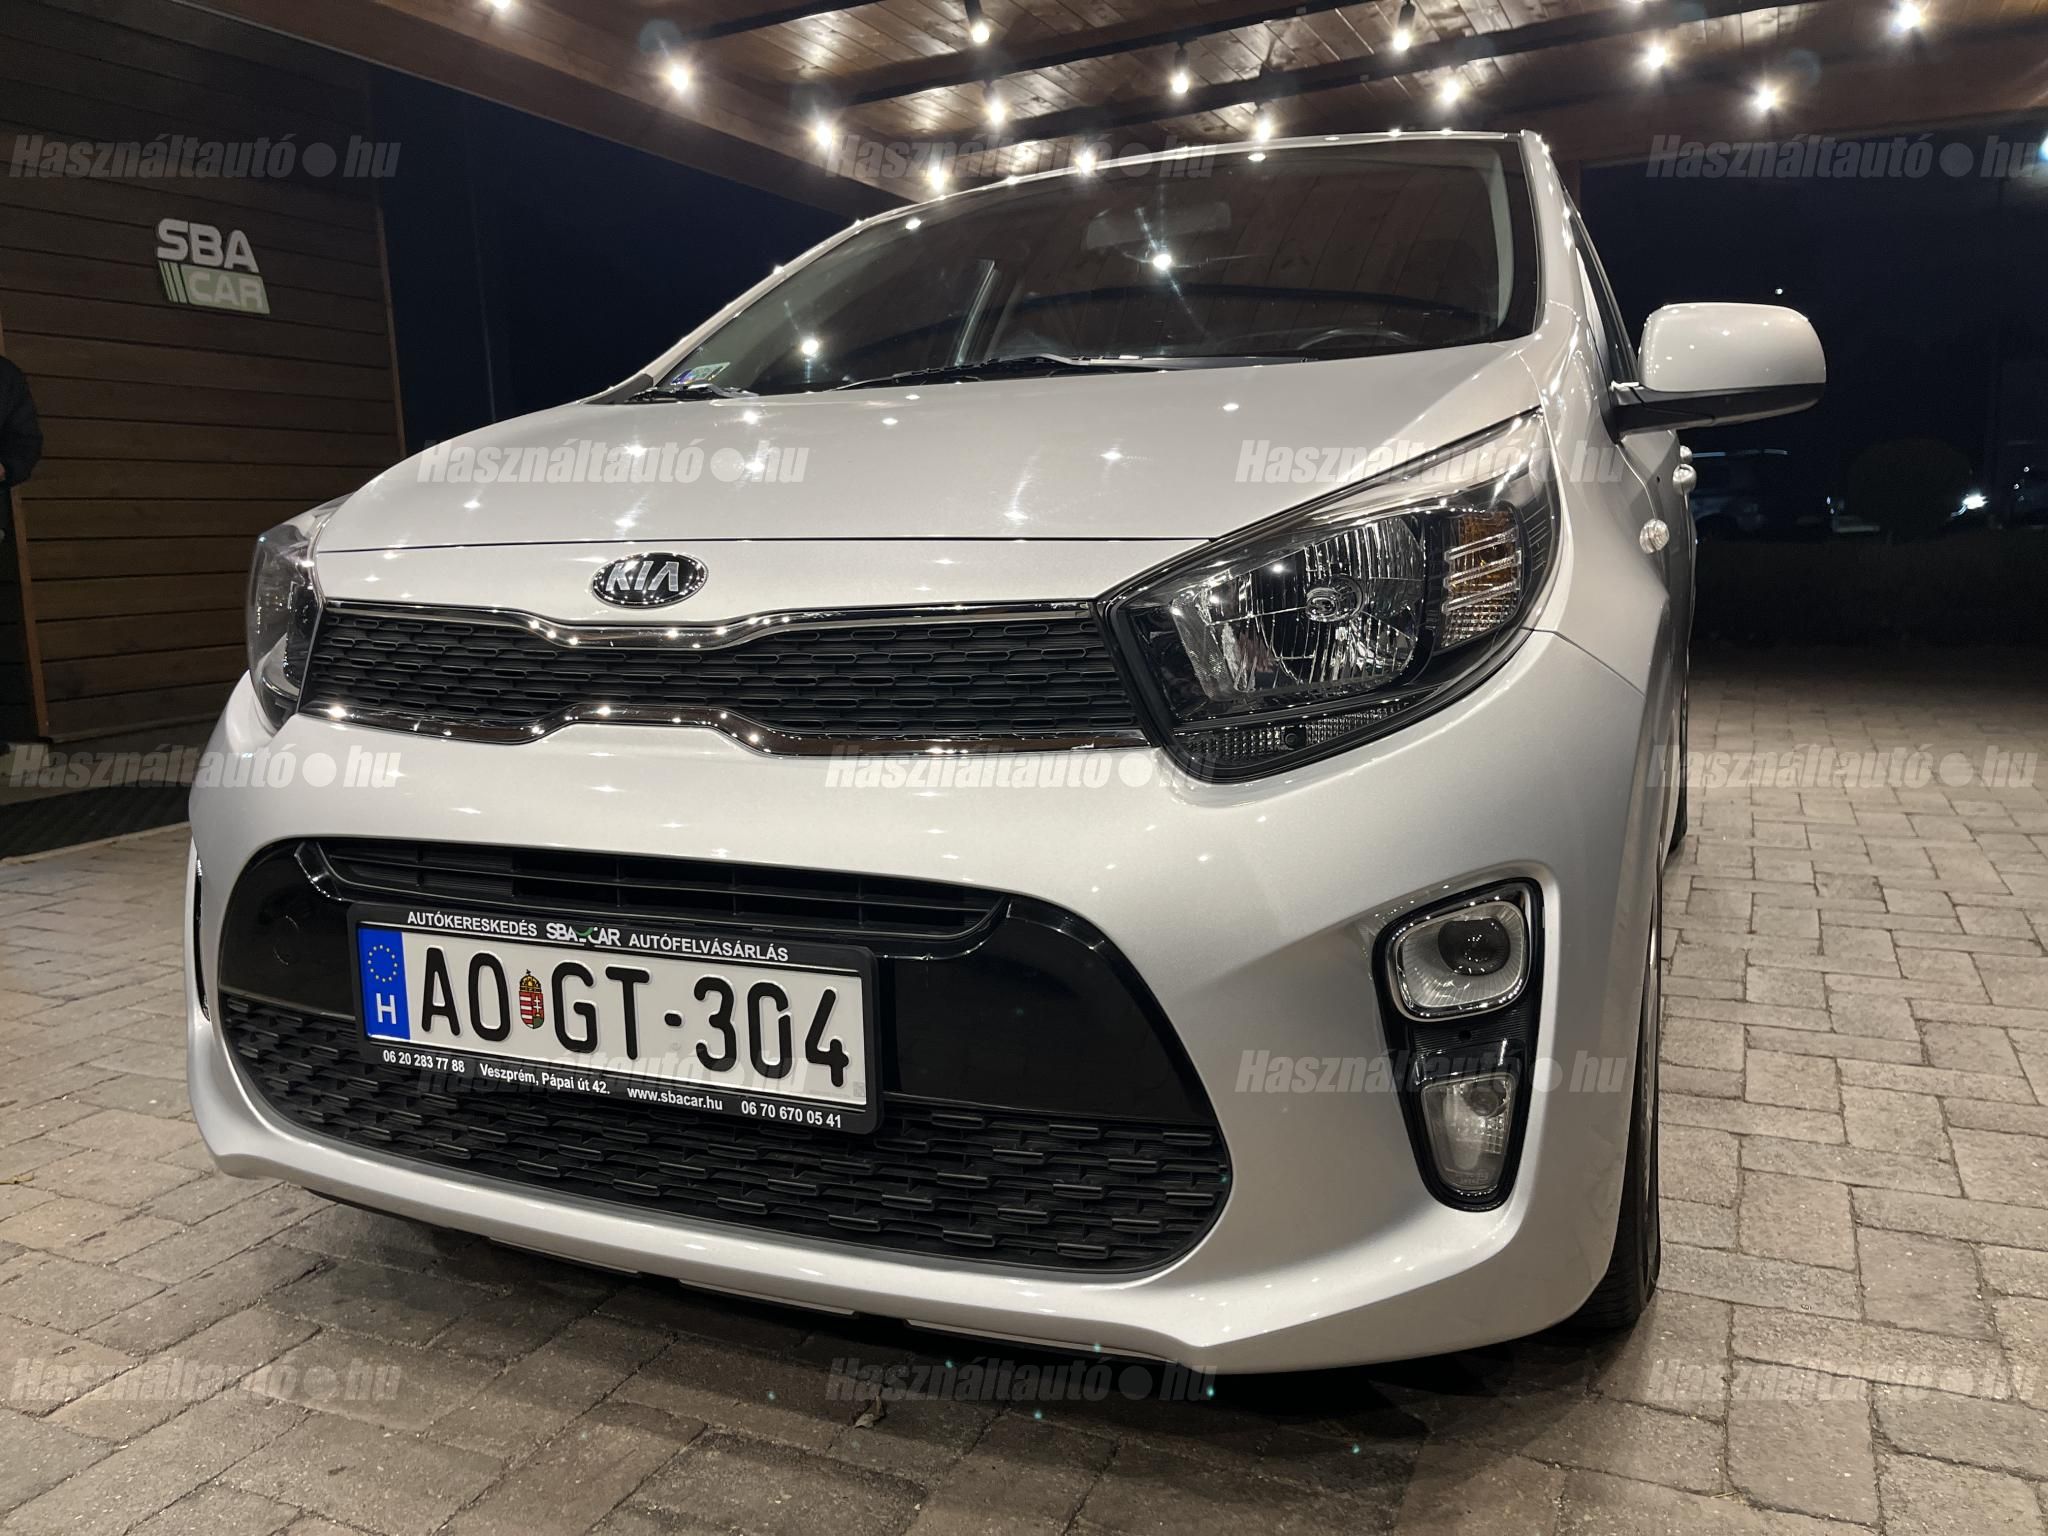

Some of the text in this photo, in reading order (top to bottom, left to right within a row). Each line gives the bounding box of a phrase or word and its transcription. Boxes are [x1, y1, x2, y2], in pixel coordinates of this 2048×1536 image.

[157, 218, 260, 273] SBA
[188, 270, 265, 310] CAR
[606, 560, 680, 592] KIA
[407, 911, 538, 937] AUTÓKERESKEDÉS
[629, 933, 789, 962] AUTÓFELVÁSÁRLÁS
[376, 992, 397, 1026] H
[383, 1050, 465, 1073] 06 20 283 77 88
[480, 1063, 611, 1094] Veszprém, Pápai út 42.
[627, 1087, 723, 1111] www.sbacar.hu
[741, 1101, 842, 1129] 06 70 670 05 41
